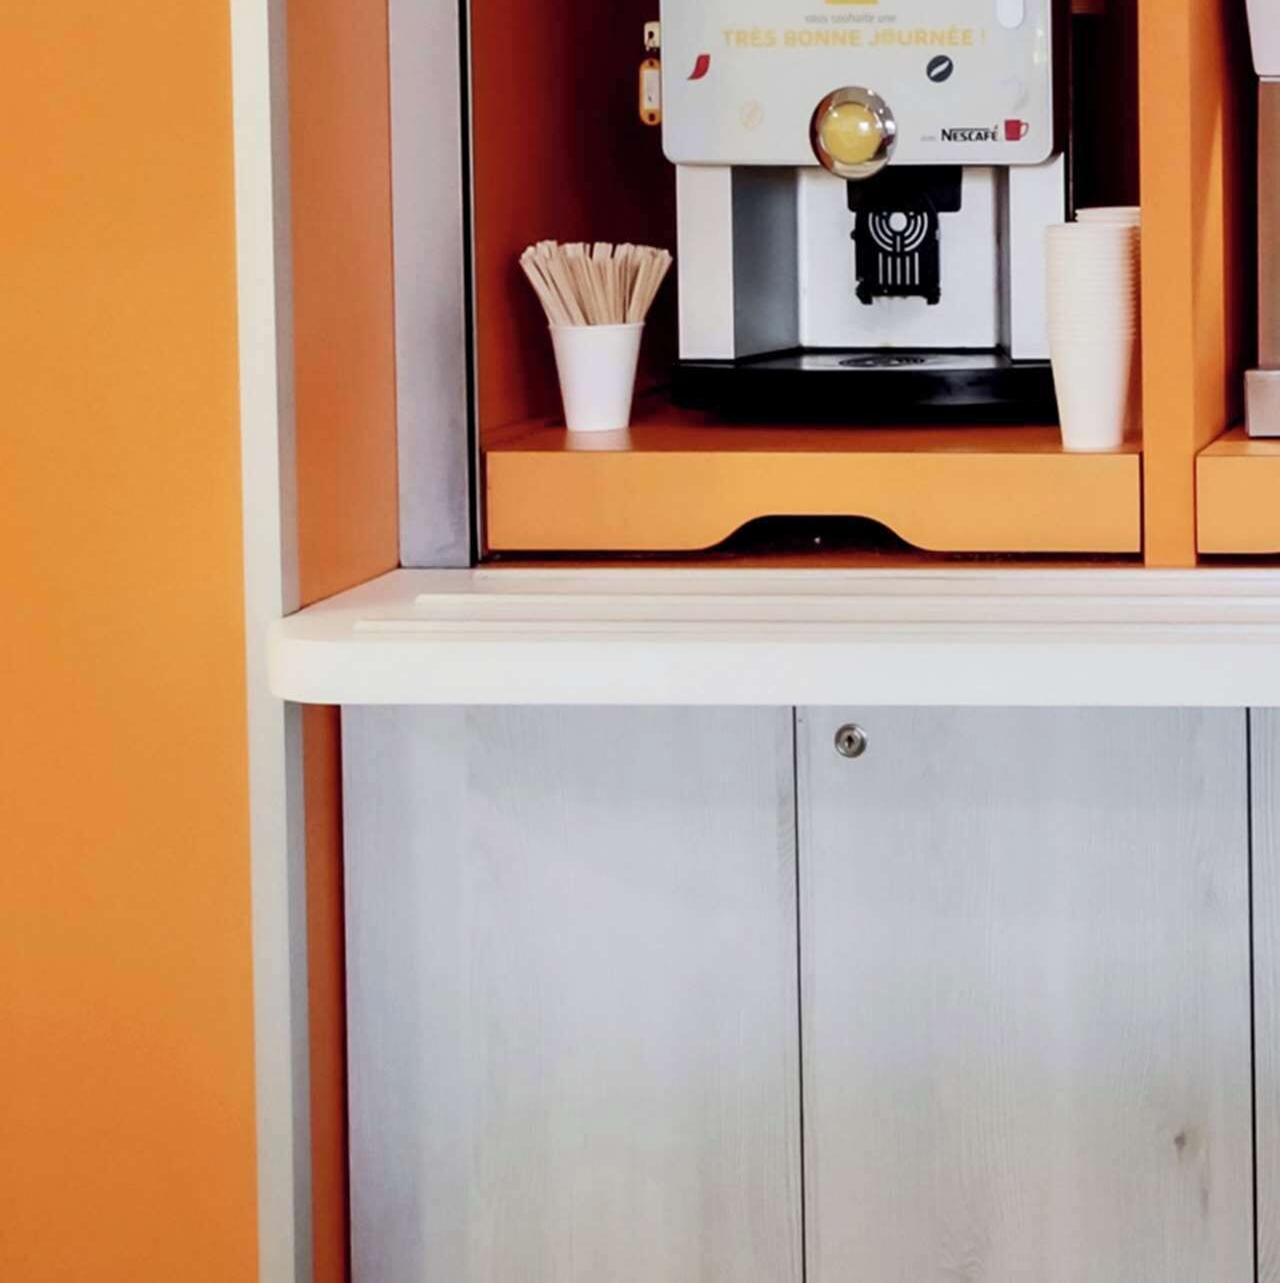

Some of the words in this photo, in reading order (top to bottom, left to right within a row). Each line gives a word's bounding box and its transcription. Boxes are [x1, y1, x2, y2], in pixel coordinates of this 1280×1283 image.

[722, 25, 777, 47] TRÈS
[783, 29, 860, 47] BONNE
[868, 25, 974, 47] JOURNÉE
[941, 124, 999, 142] NESCAFÉ
